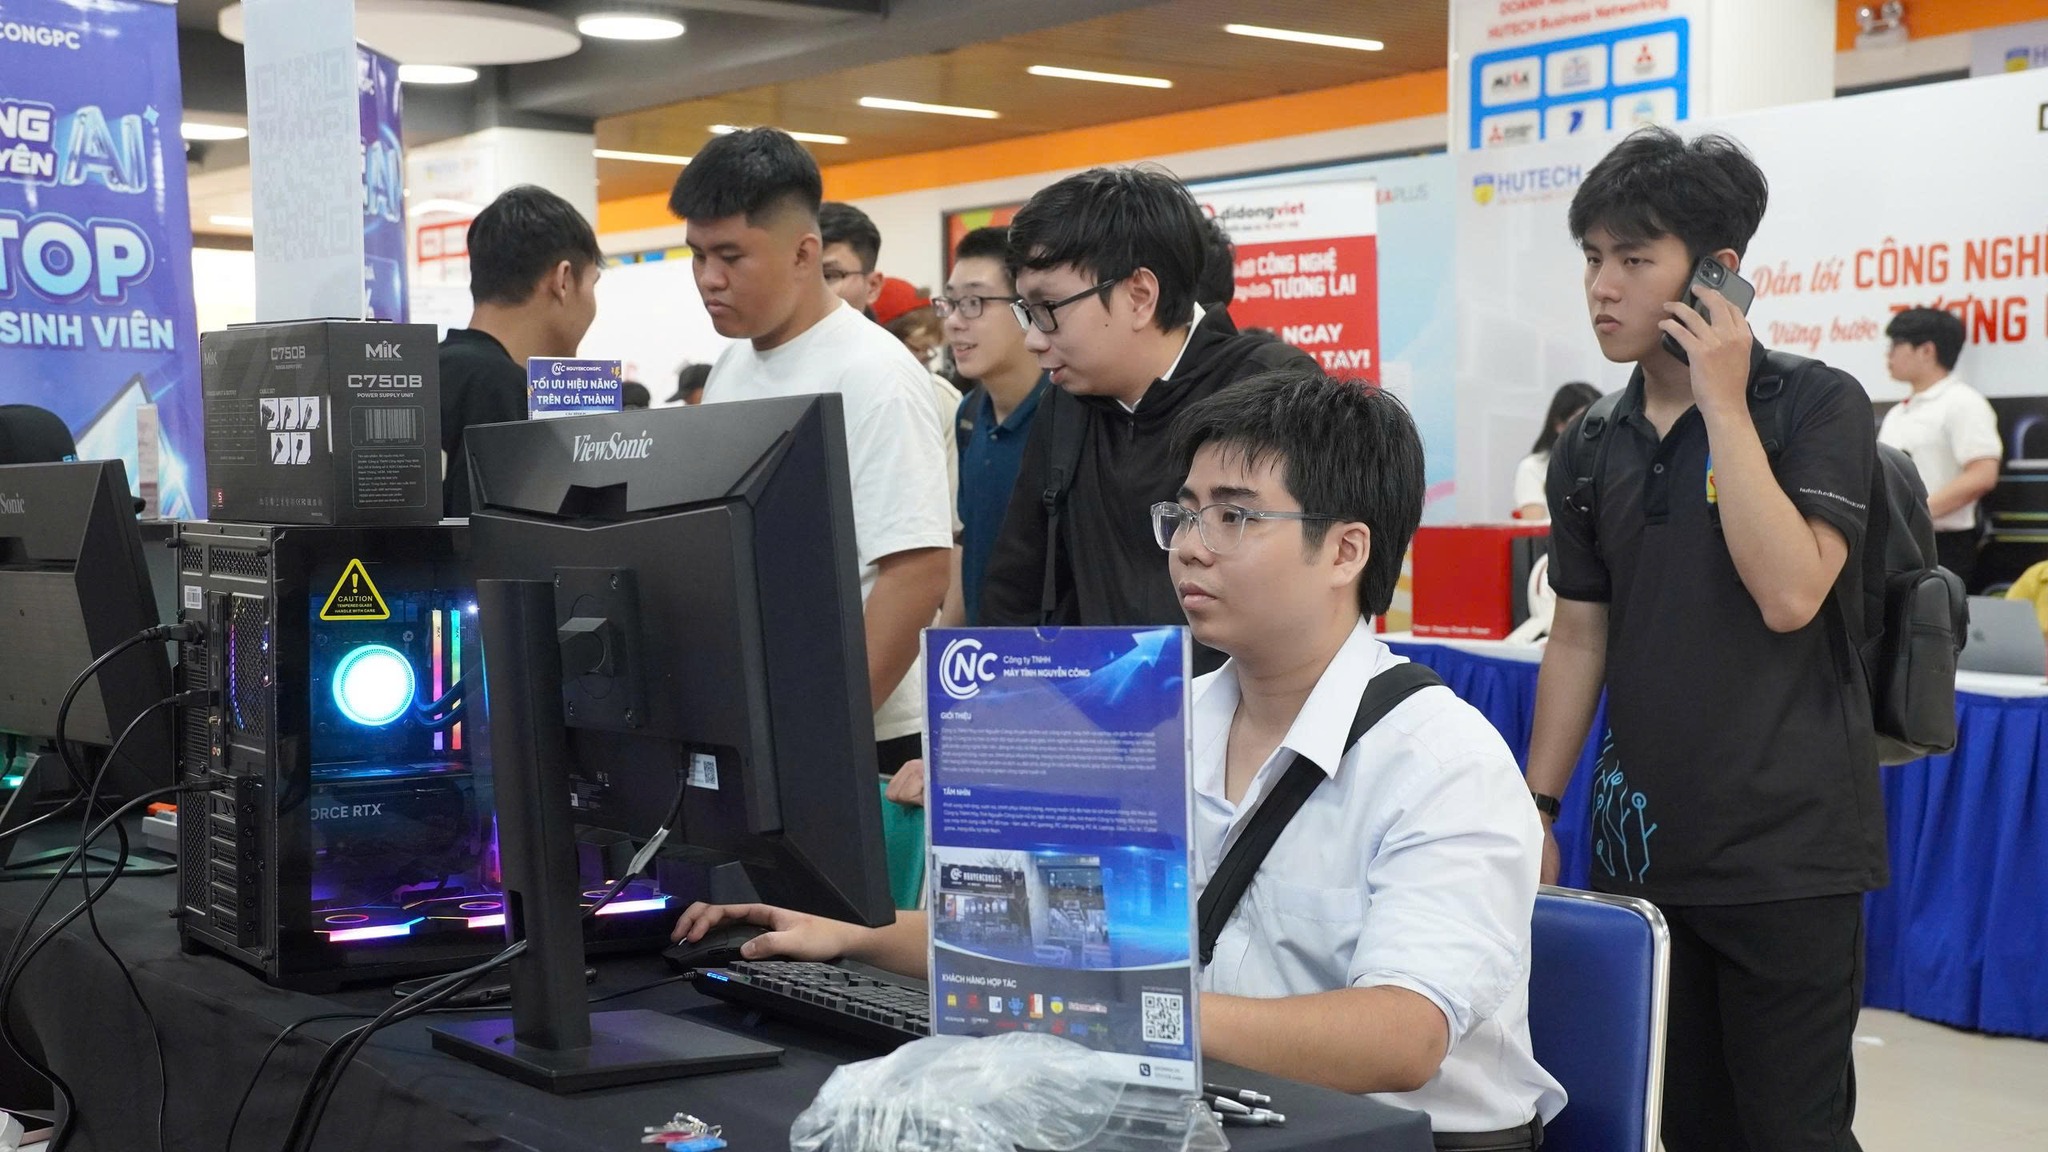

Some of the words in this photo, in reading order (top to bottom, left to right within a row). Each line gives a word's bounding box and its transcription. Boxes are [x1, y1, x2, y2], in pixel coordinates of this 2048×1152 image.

[62, 105, 148, 194] AI
[1498, 165, 1581, 192] HUTECH
[1257, 251, 1295, 276] CÔNG
[1298, 247, 1336, 273] NGHỆ
[1854, 236, 1949, 289] CÔNG
[1328, 273, 1356, 296] LAI
[0, 311, 84, 346] SINH
[91, 310, 175, 349] VIÊN
[1282, 323, 1343, 345] NGAY
[270, 346, 306, 360] C750B
[1321, 348, 1371, 369] TAY!
[347, 374, 423, 388] C750B
[532, 376, 549, 389] TỐI
[551, 379, 565, 389] ƯU
[567, 378, 588, 392] HIỆU
[590, 378, 618, 390] NĂNG
[537, 393, 560, 404] TRÊN
[563, 393, 581, 404] GIÁ
[582, 392, 615, 405] THÀNH
[572, 430, 653, 462] ViewSonic
[1003, 655, 1022, 665] Công
[1023, 657, 1030, 665] ty
[1031, 656, 1051, 664] TNHH
[1003, 668, 1019, 677] MÁY
[1020, 668, 1037, 677] TÍNH
[1067, 669, 1091, 678] CÔNG
[955, 711, 972, 720] THIỆU
[353, 803, 382, 817] RTX
[942, 973, 965, 983] KHÁCH
[966, 975, 986, 986] HÀNG
[987, 977, 1002, 988] HỢP
[1002, 977, 1017, 988] TÁC
